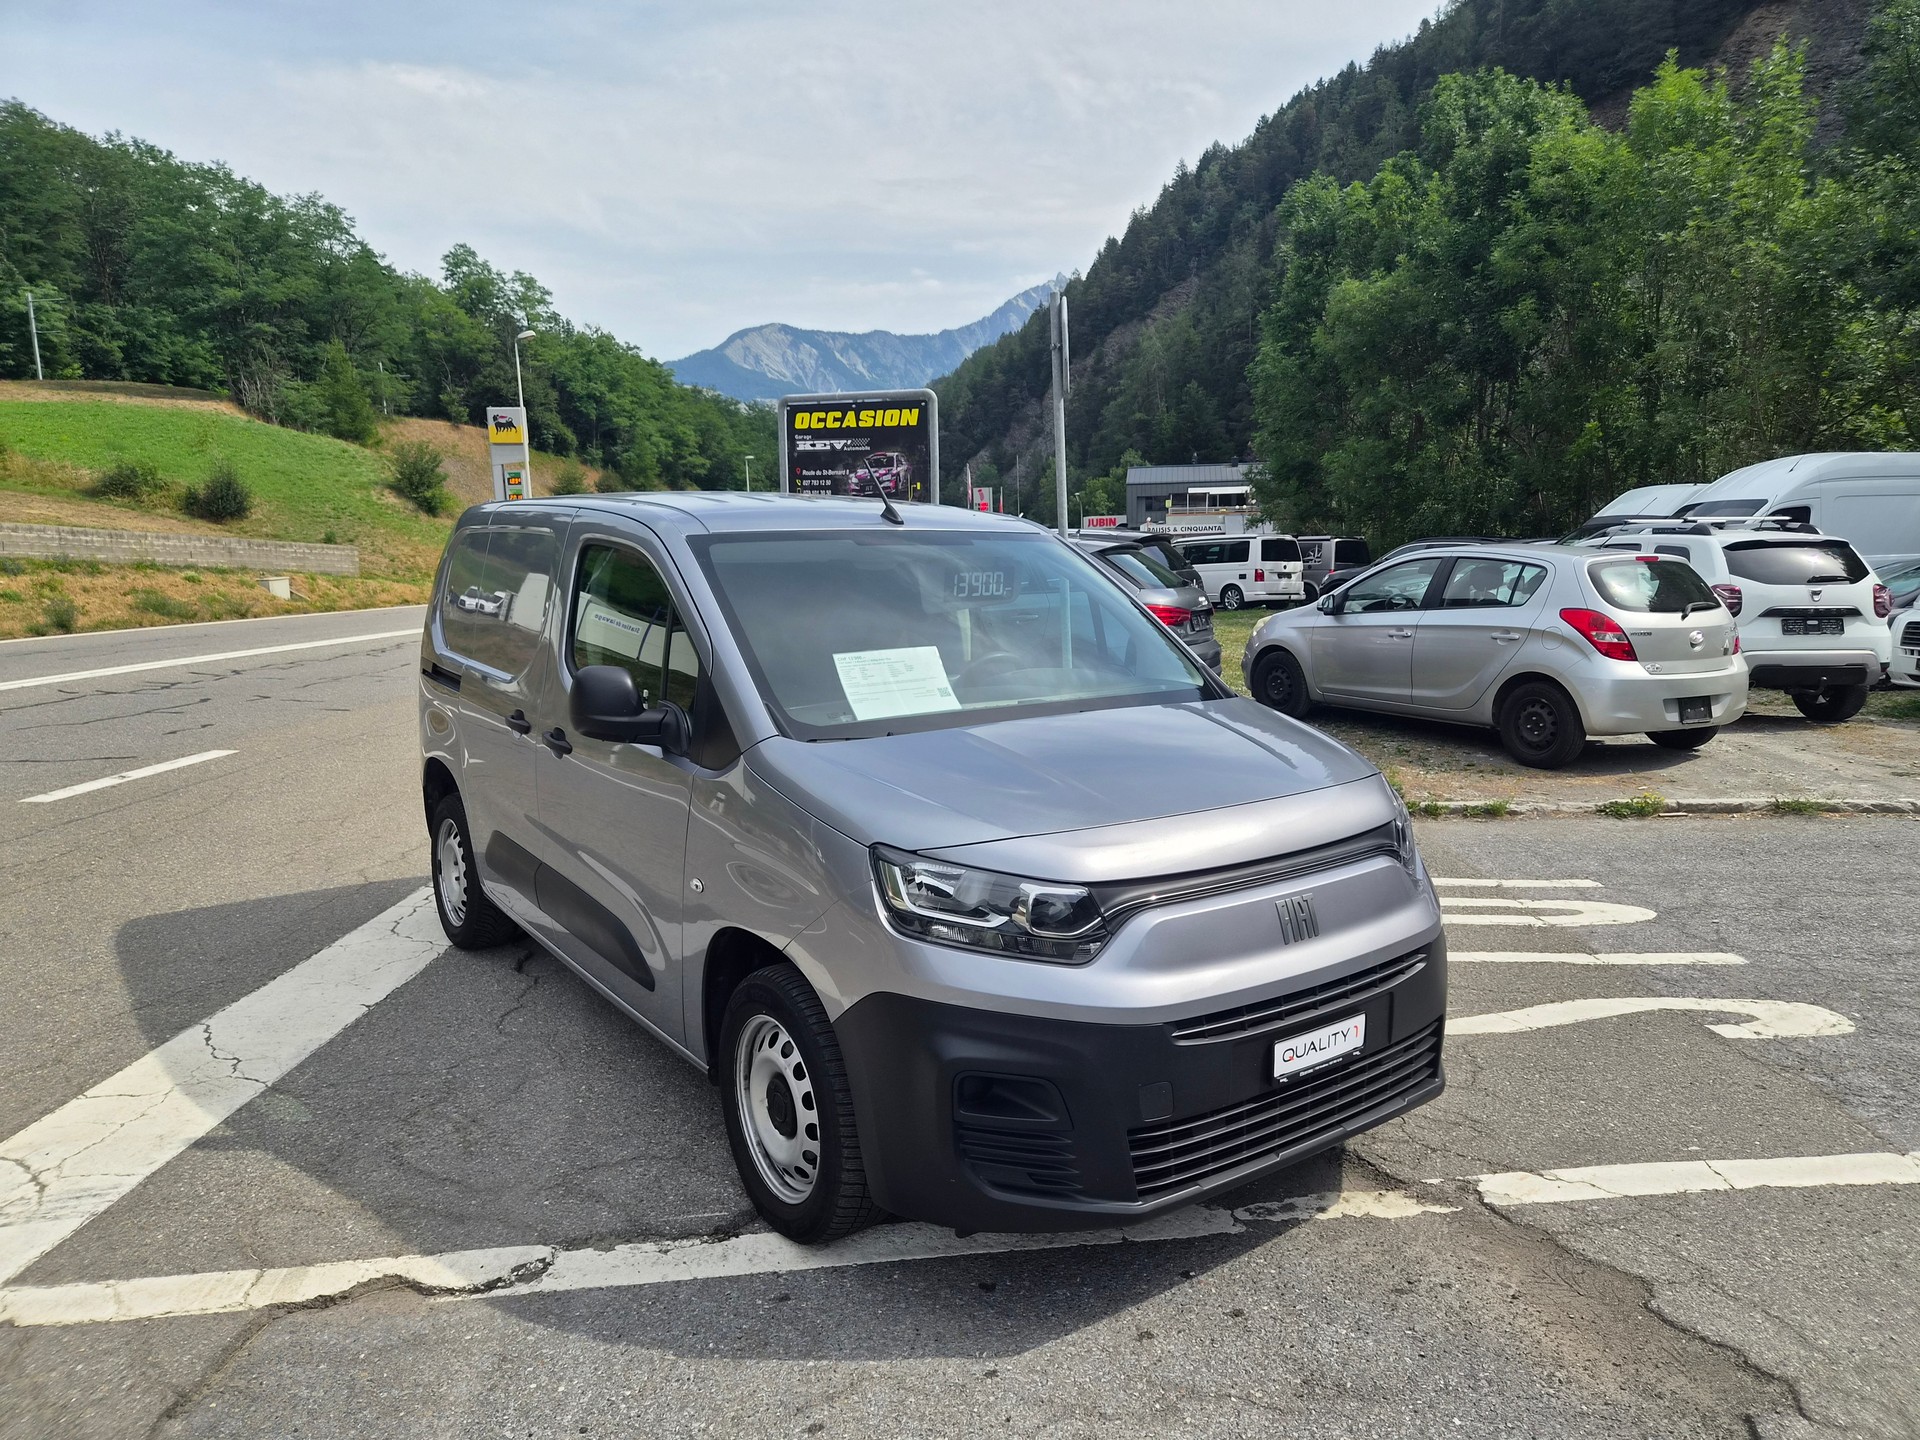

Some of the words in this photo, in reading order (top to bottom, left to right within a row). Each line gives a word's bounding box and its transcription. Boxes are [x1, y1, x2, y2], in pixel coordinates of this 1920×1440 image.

[795, 409, 919, 429] OCCASION
[1087, 517, 1117, 528] JUBIN
[1275, 892, 1320, 945] FIAT
[1282, 1027, 1351, 1063] QUALITY
[1353, 1025, 1359, 1038] 1
